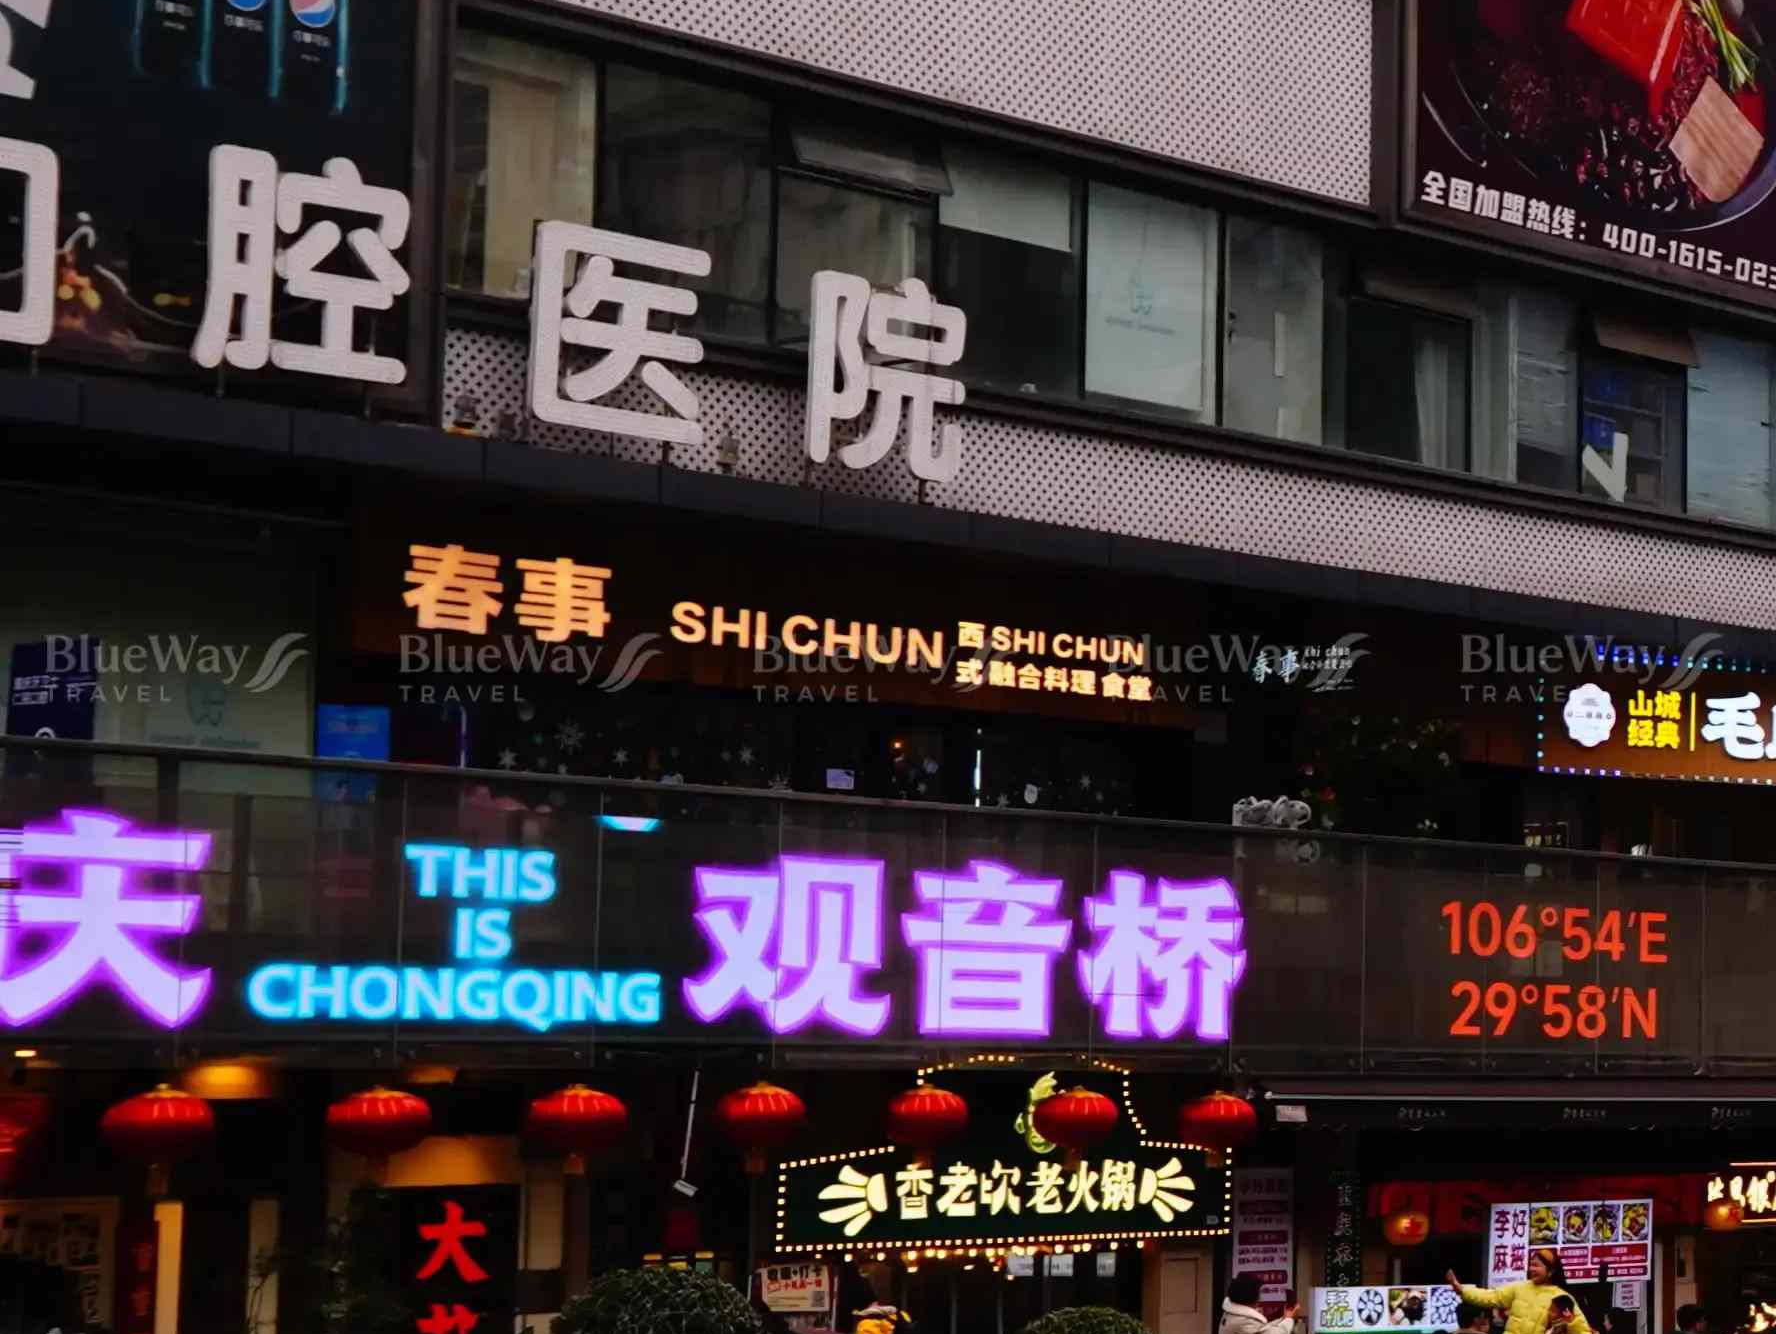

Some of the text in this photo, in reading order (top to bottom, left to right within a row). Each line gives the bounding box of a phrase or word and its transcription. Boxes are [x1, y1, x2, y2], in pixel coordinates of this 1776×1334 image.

[403, 543, 612, 644] 春事
[668, 601, 945, 671] SHI CHUN
[991, 626, 1046, 655] SHI
[1052, 633, 1145, 666] CHUN
[988, 660, 1097, 696] 融合料理
[1102, 671, 1153, 702] 食堂
[1628, 689, 1682, 719] 山城
[1627, 718, 1681, 750] 经典
[404, 842, 557, 903] THIS
[454, 908, 513, 960] IS
[682, 854, 1248, 1041] 观音桥
[247, 964, 662, 1032] CHONGQING
